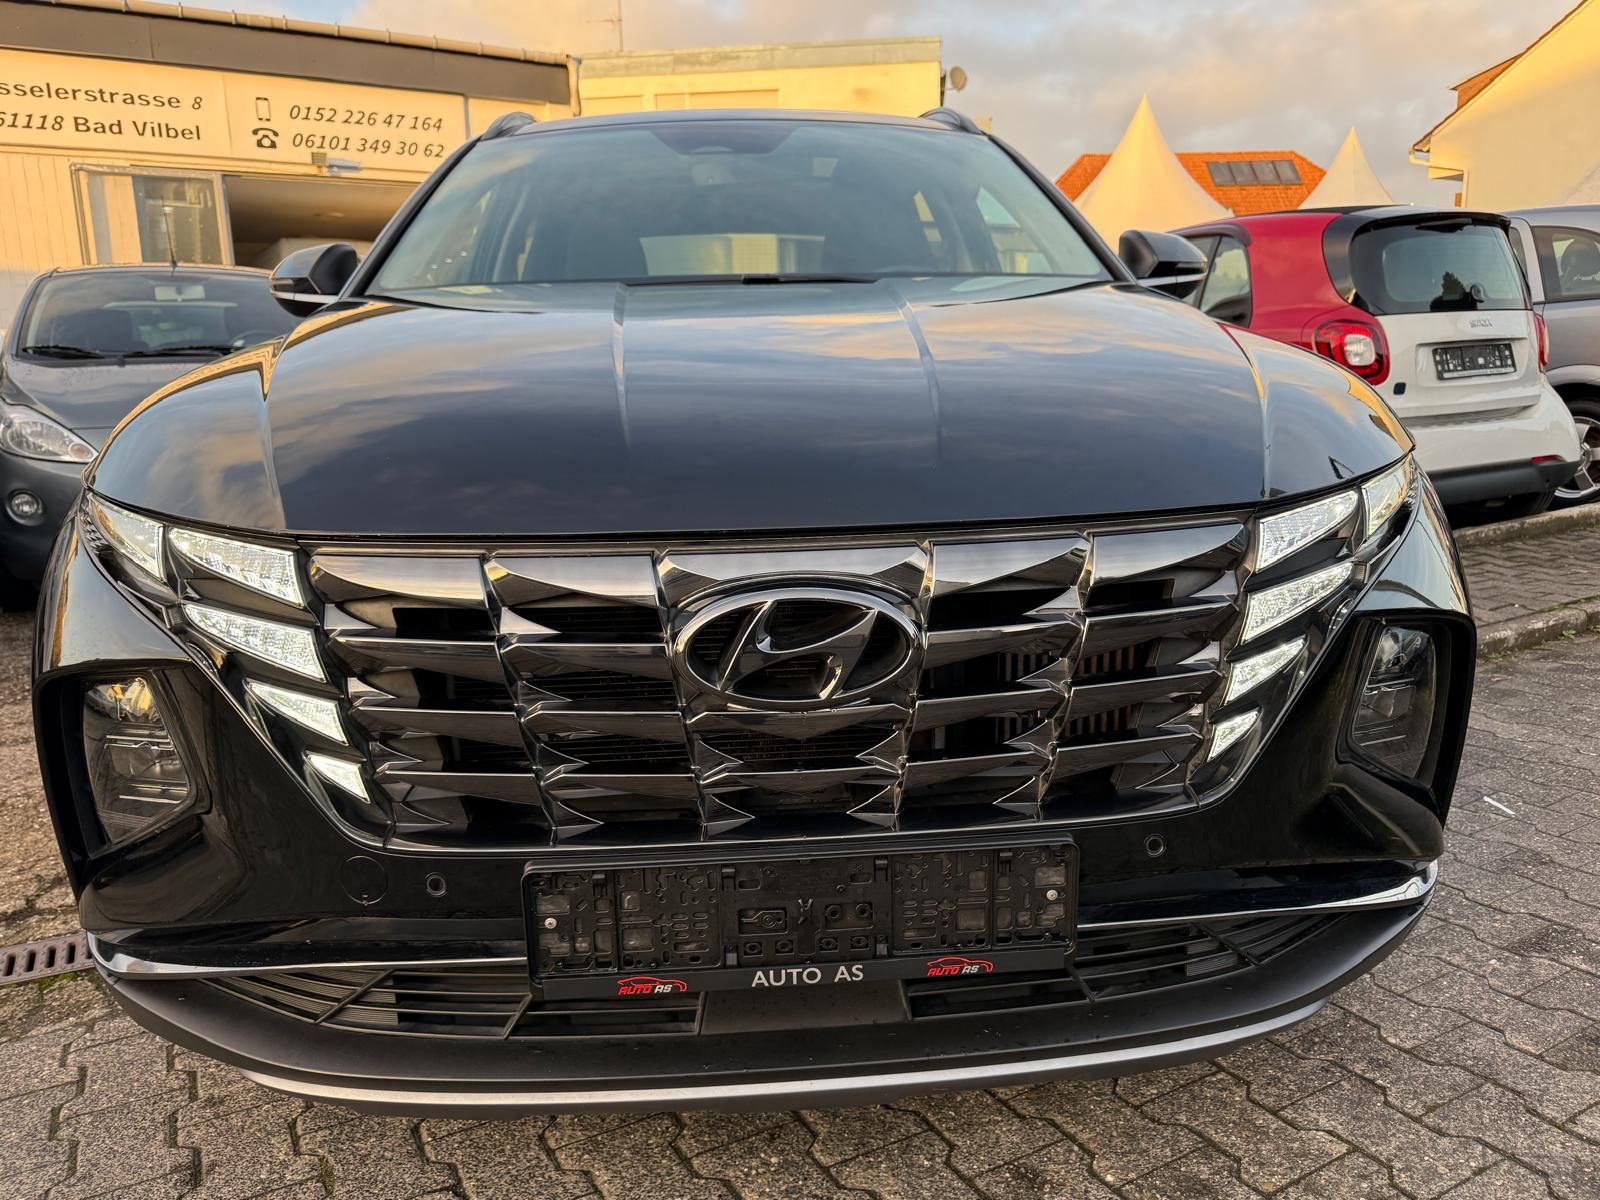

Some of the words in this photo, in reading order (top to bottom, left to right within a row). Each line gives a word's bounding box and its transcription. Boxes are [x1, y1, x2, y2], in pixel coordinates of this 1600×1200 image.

[191, 96, 203, 110] 8
[73, 116, 123, 136] Bad
[131, 120, 201, 140] Vilbel
[289, 104, 337, 123] 0152
[342, 109, 378, 126] 226
[383, 113, 405, 129] 47
[409, 116, 443, 131] 164
[292, 132, 351, 151] 06101
[356, 138, 391, 154] 349
[395, 141, 418, 156] 30
[423, 143, 445, 158] 62
[751, 967, 822, 987] AUTO
[834, 964, 864, 982] AS
[927, 966, 961, 976] AUTO
[961, 965, 980, 974] AS
[618, 984, 653, 995] AUTO
[654, 984, 673, 994] AS
